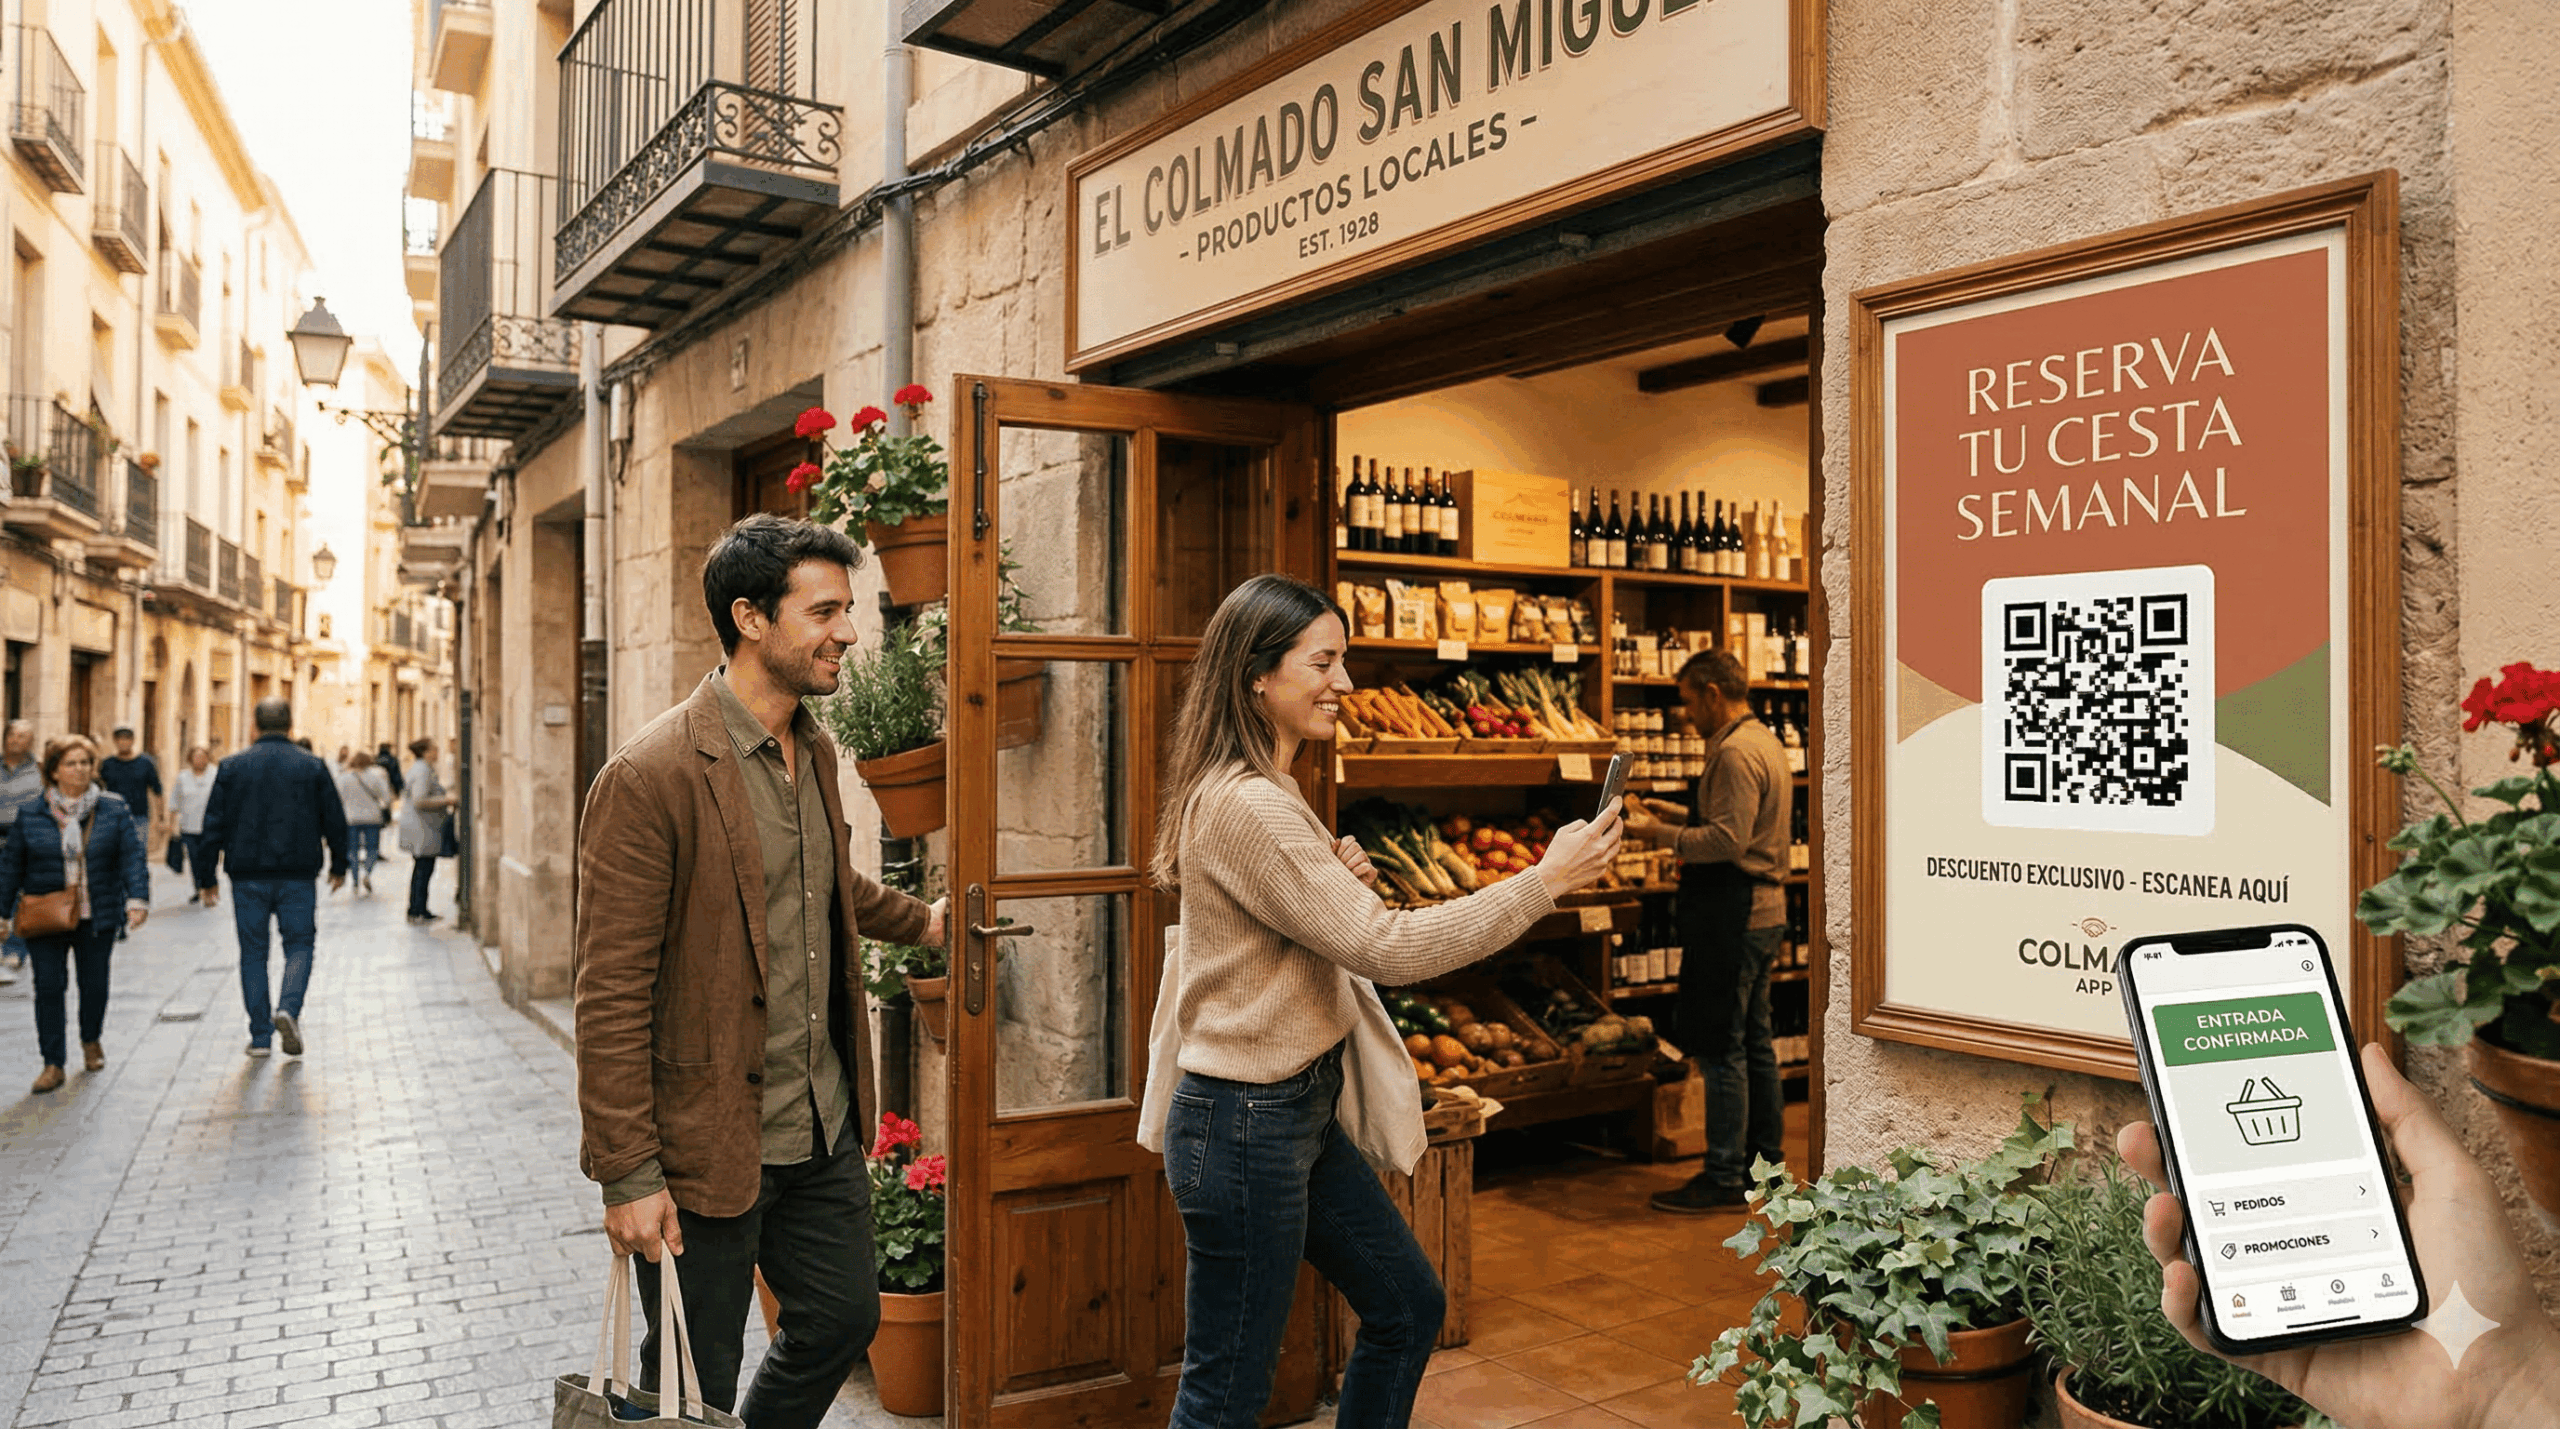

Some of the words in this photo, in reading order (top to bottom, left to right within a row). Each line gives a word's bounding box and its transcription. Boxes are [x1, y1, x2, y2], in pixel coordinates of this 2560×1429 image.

[1095, 184, 1132, 256] EL
[1144, 83, 1339, 234] COLMADO
[1358, 20, 1462, 142] SAN
[1487, 0, 1713, 91] MIG
[1197, 173, 1352, 262] PRODUCTOS
[1363, 112, 1508, 199] LOCALES
[1299, 229, 1334, 259] EST.
[1339, 211, 1379, 245] 1928
[1968, 327, 2236, 416] RESERVA
[1958, 424, 2027, 477] TU
[2047, 395, 2243, 467] CESTA
[1956, 467, 2247, 541] SEMANAL
[1926, 856, 2022, 884] DESCUENTO
[2026, 863, 2125, 892] EXCLUSIVO
[2142, 871, 2233, 899] ESCANEA
[2238, 874, 2290, 904] AQUÍ
[2018, 937, 2117, 974] COLM
[2075, 977, 2113, 996] APP
[2183, 1026, 2310, 1051] CONFIRMADA
[2196, 1008, 2287, 1030] ENTRADA
[2234, 1195, 2286, 1212] PEDIDOS
[2244, 1234, 2330, 1255] PROMOCIONES
